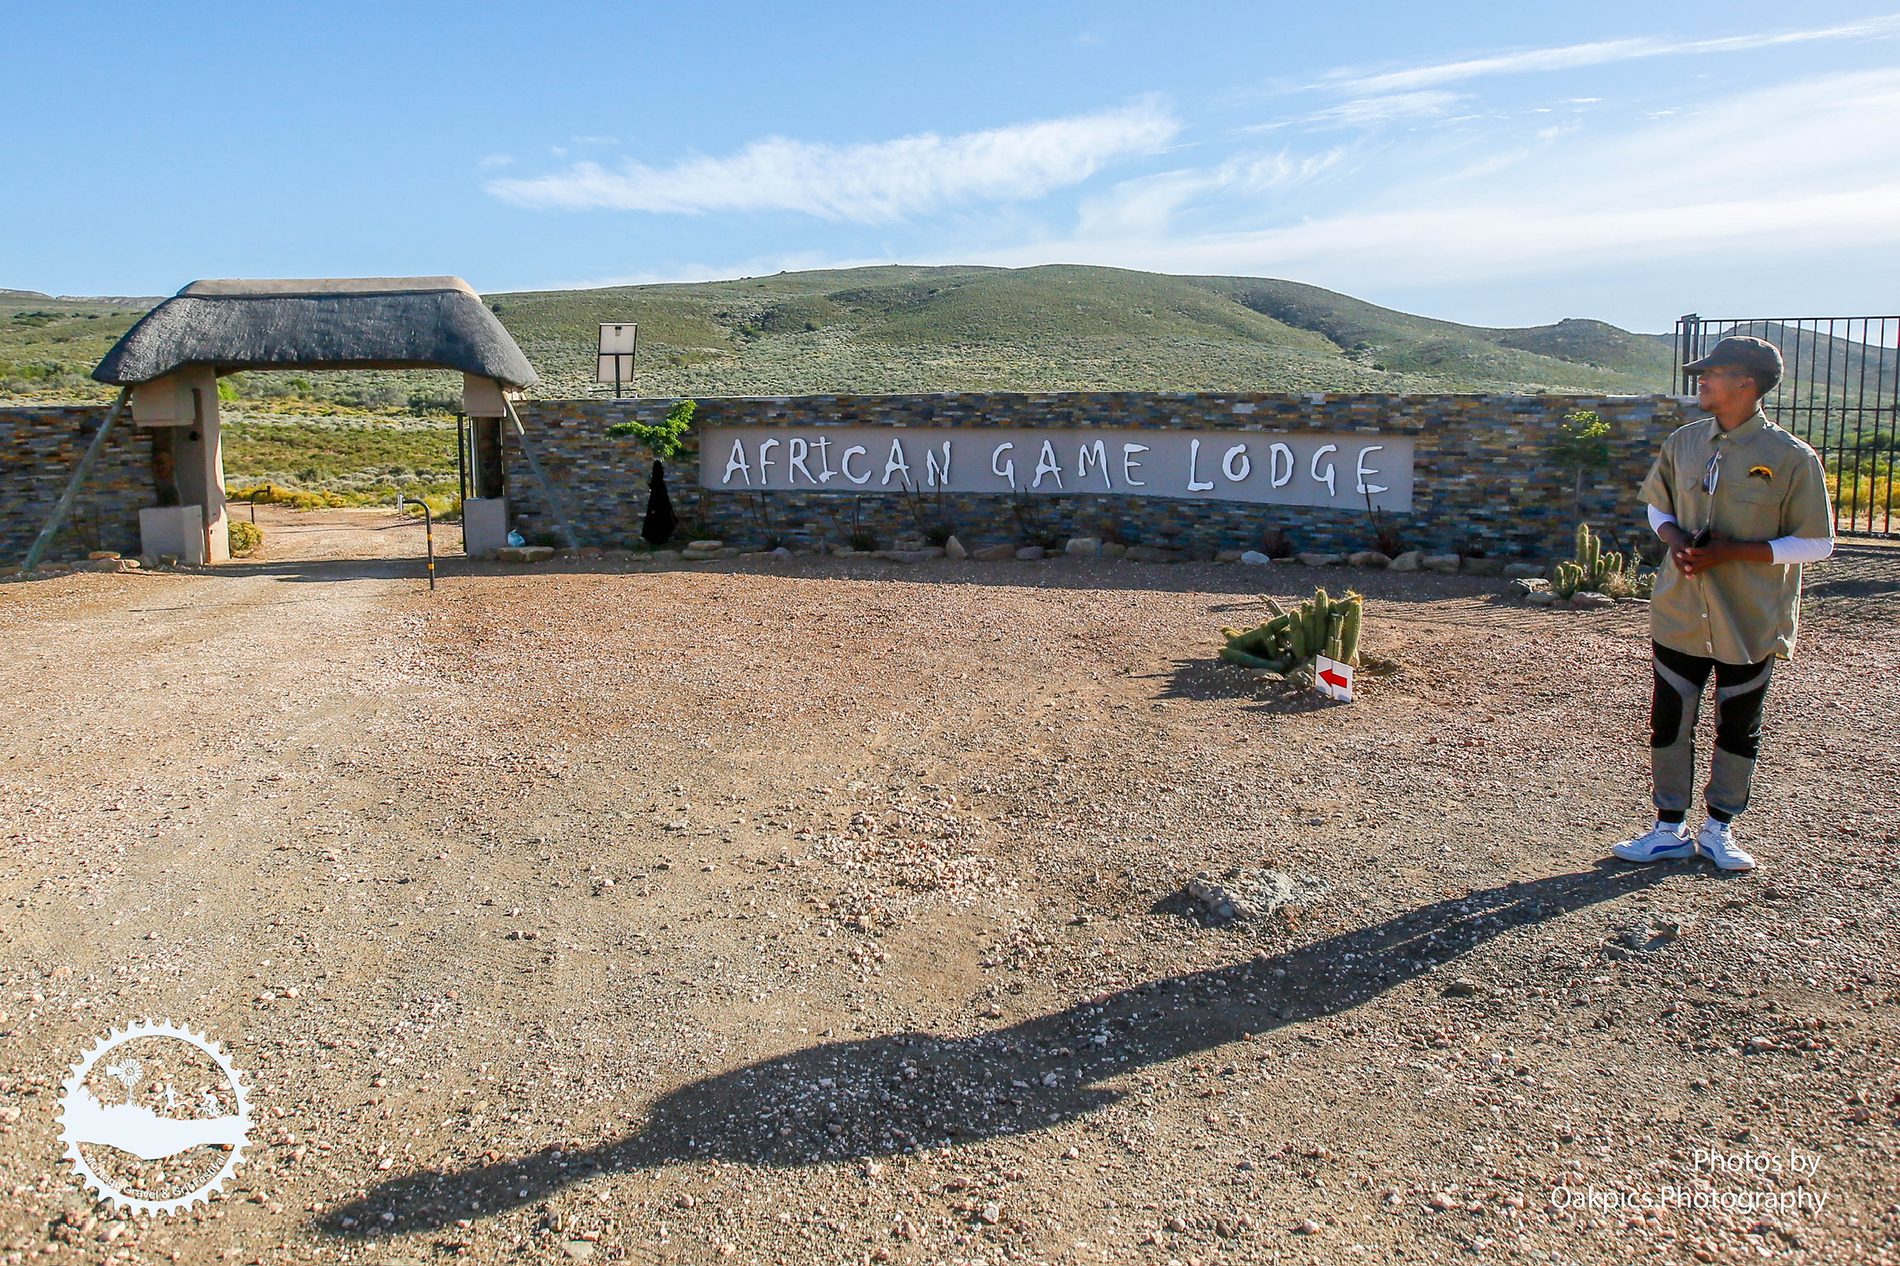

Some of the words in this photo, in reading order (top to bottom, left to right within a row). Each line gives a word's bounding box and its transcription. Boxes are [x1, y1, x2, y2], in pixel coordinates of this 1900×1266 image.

[722, 436, 951, 487] AFRICAN
[992, 439, 1150, 489] GAME
[1187, 438, 1389, 497] LODGE
